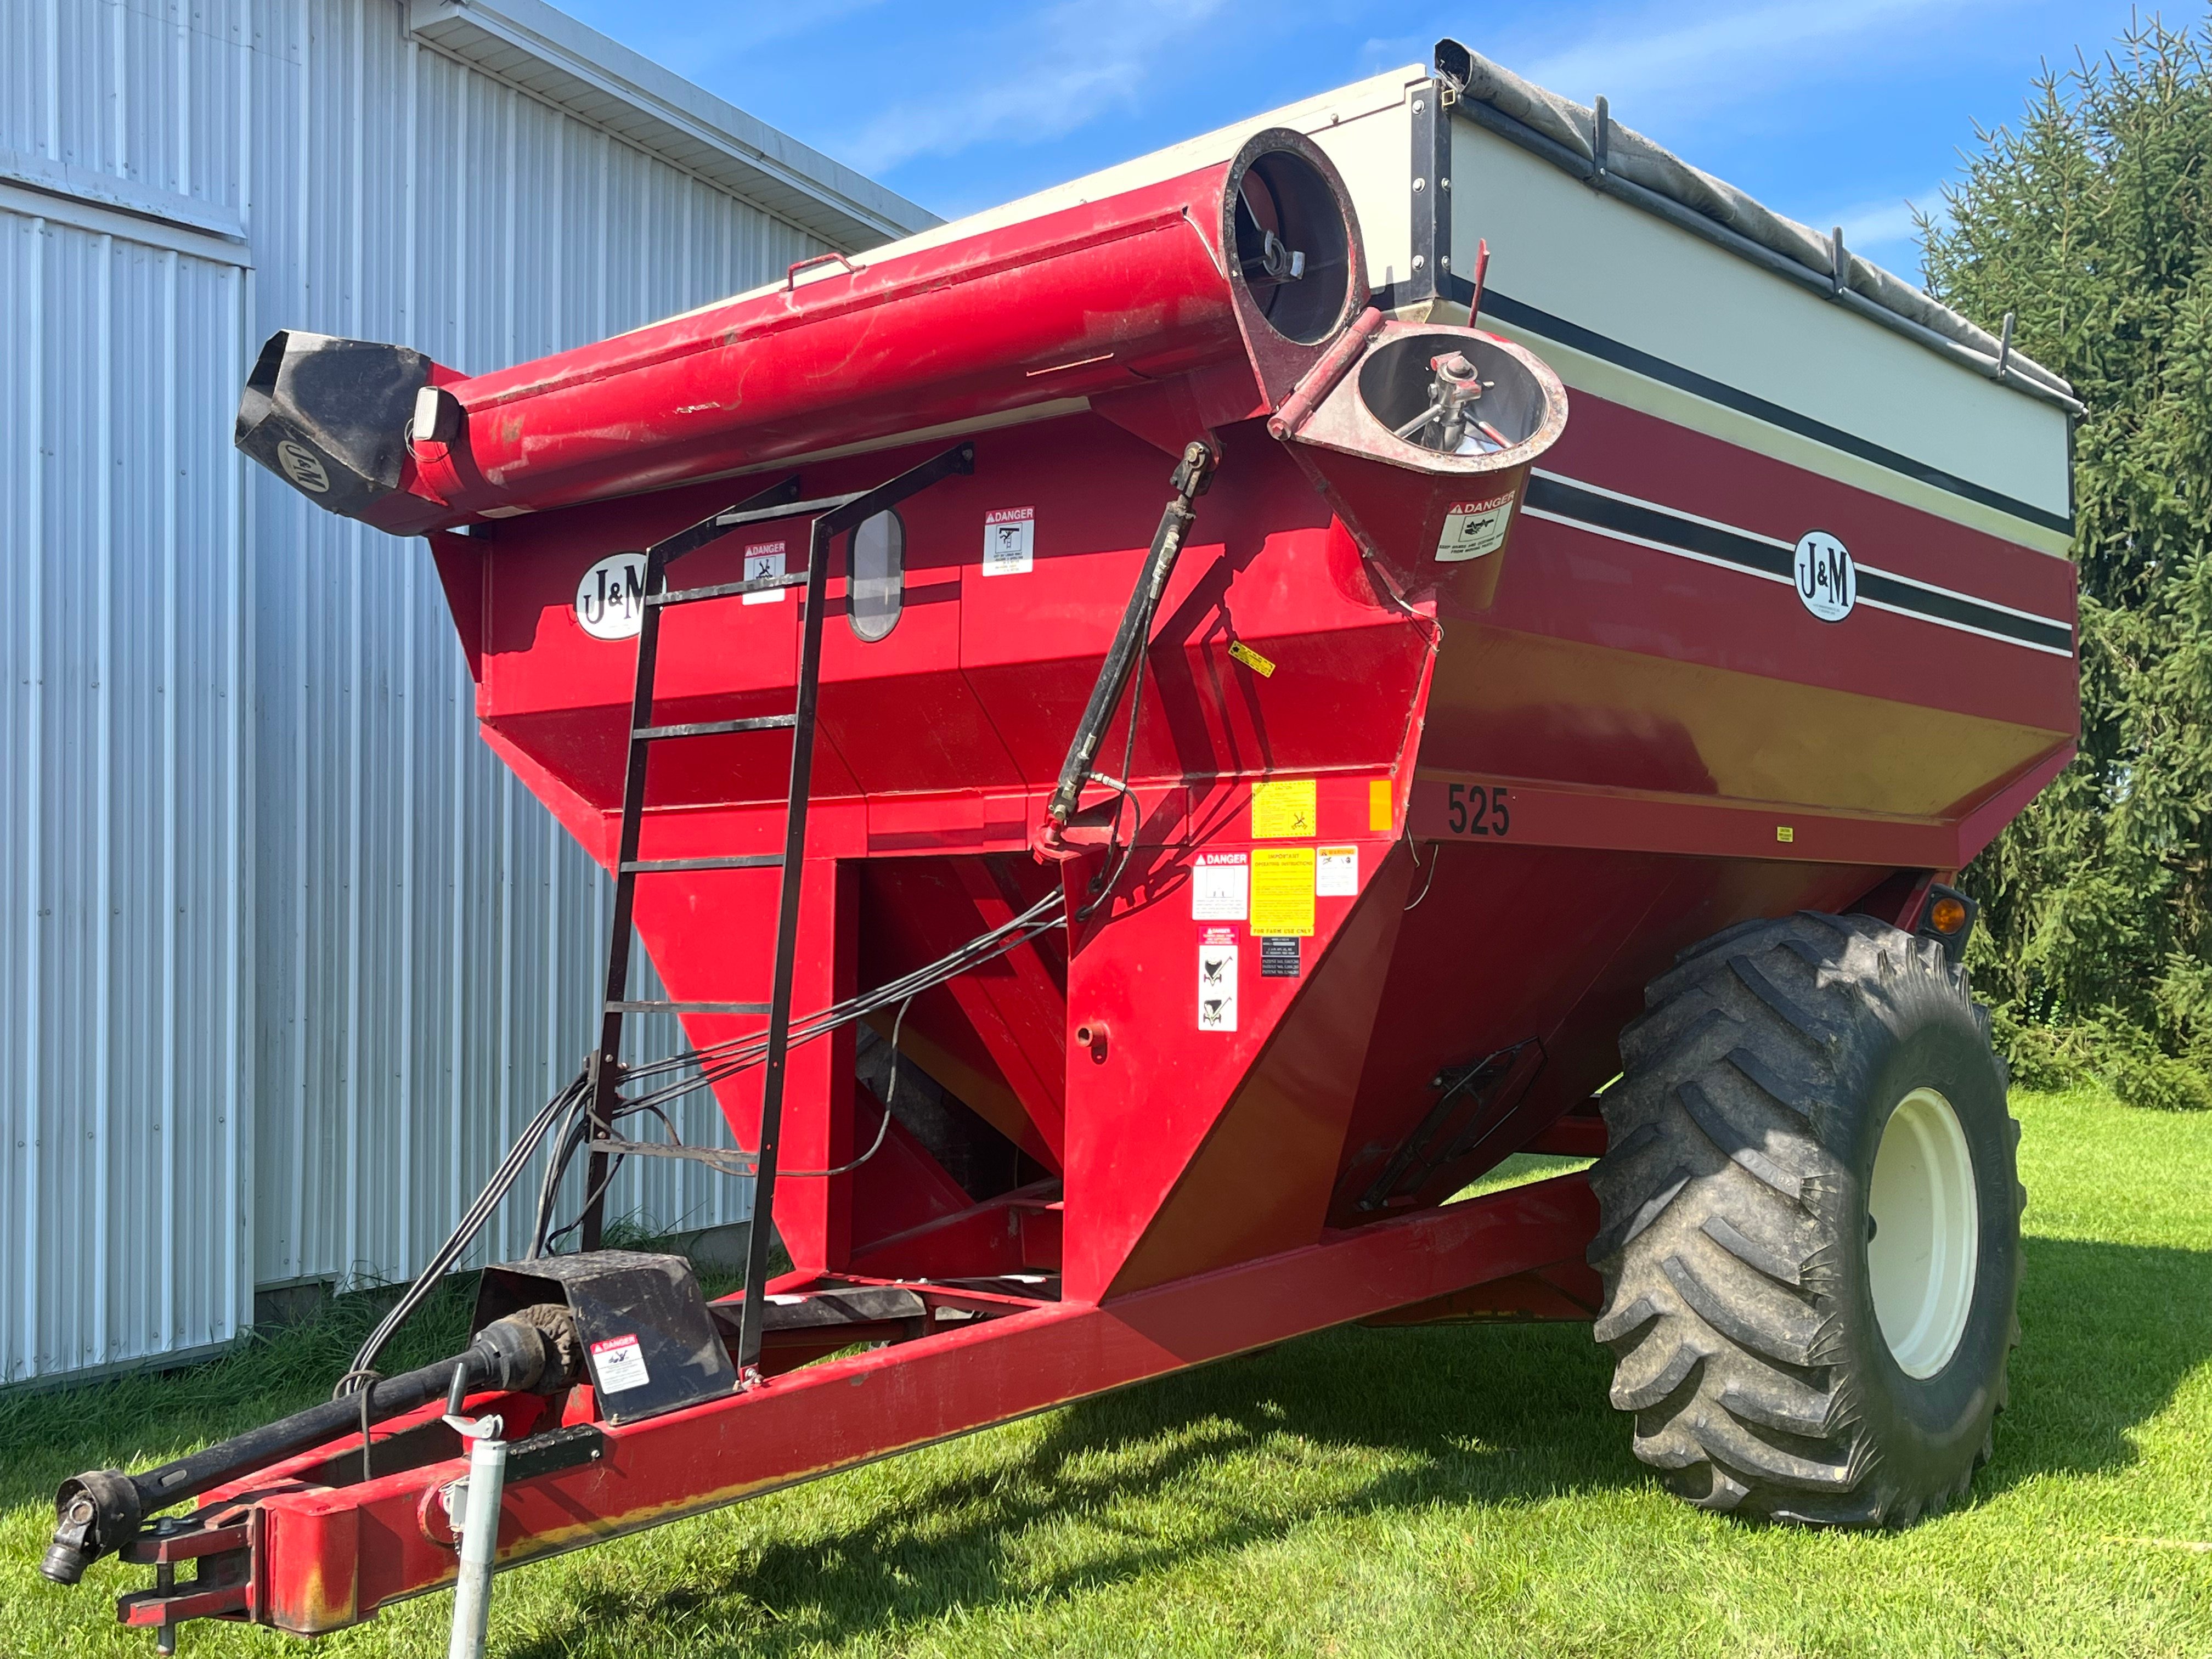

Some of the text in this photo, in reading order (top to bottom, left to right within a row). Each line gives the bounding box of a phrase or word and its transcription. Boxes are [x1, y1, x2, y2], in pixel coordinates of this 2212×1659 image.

[285, 444, 327, 489] J&M
[1464, 490, 1516, 514] DANGER
[995, 508, 1034, 522] DANGER
[753, 543, 785, 555] DANGER
[1799, 541, 1849, 607] J&M
[1449, 783, 1509, 836] 525
[1207, 854, 1247, 865] DANGER
[602, 1336, 636, 1350] DANGER
